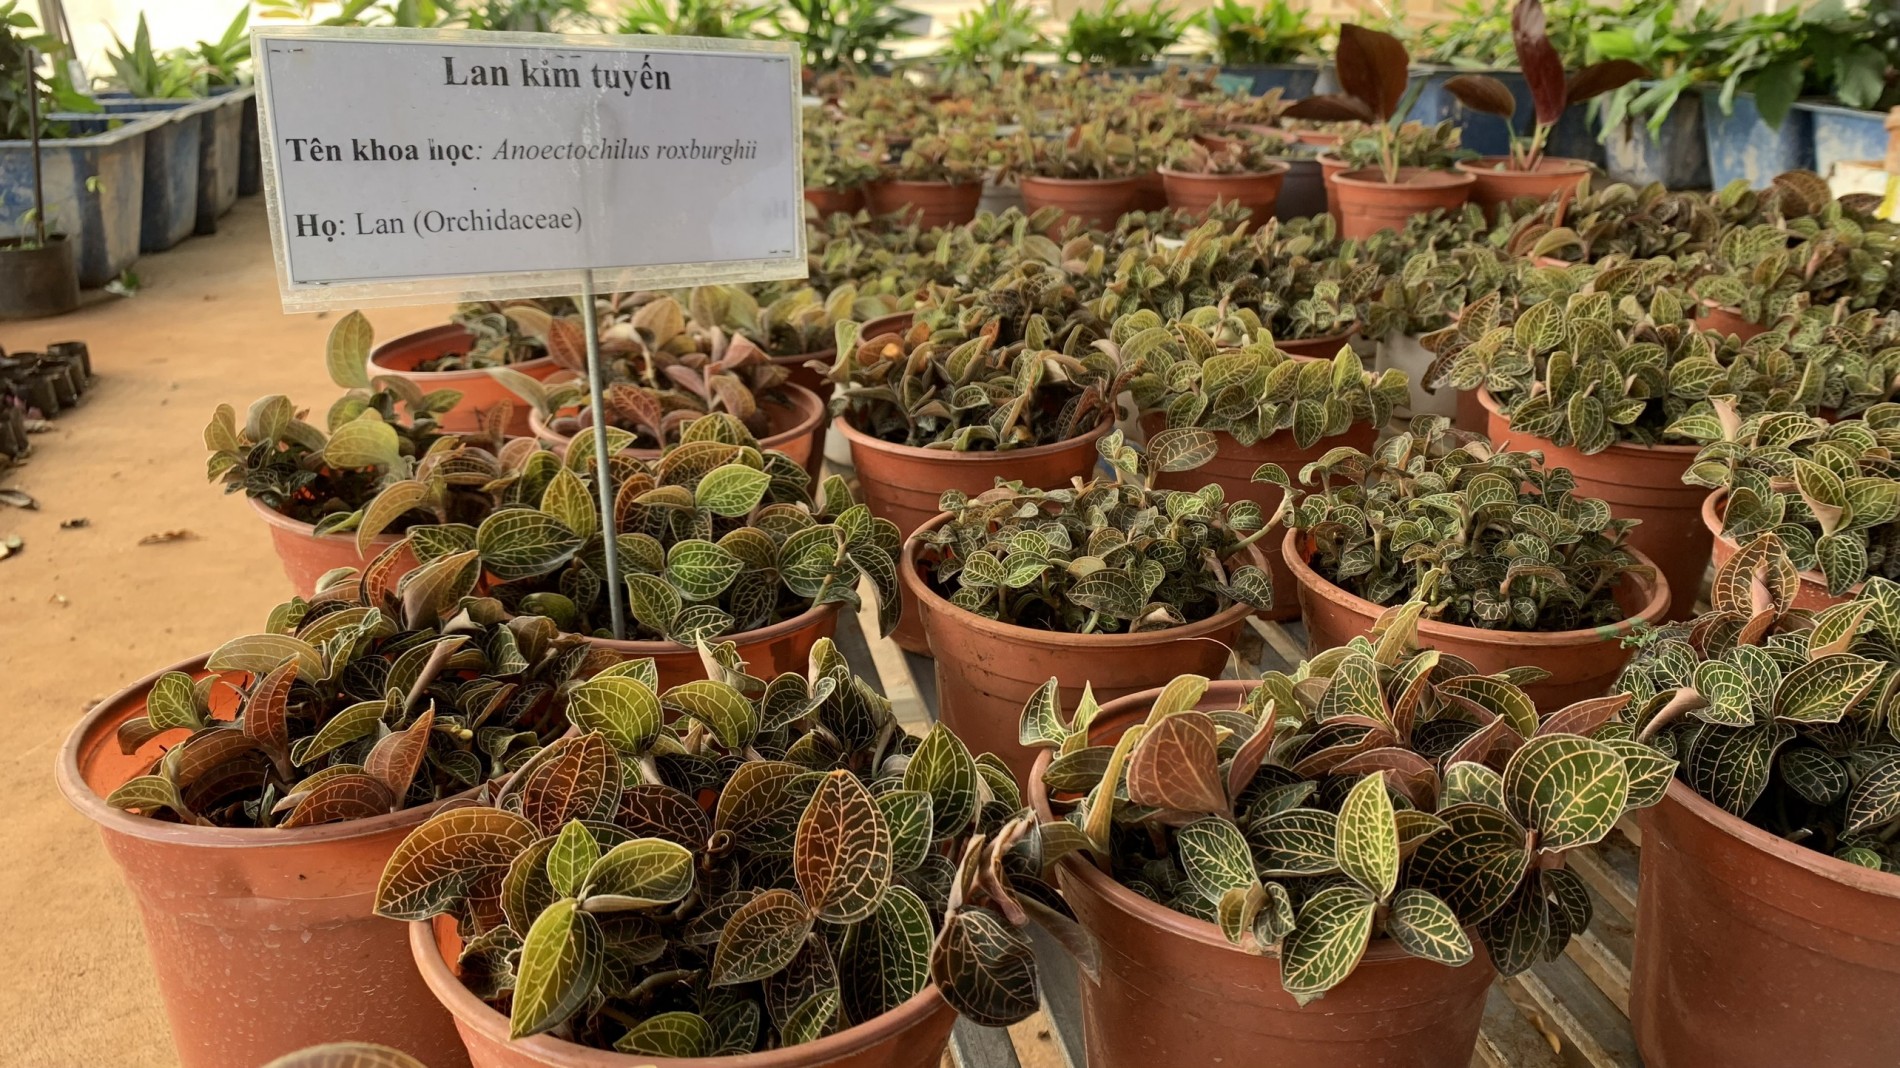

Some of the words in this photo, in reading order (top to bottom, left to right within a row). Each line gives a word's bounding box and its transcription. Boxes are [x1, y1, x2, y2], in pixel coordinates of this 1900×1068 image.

[441, 56, 510, 86] Lan
[590, 54, 672, 97] tuyến
[285, 137, 343, 162] Tên
[351, 138, 420, 162] khoa
[492, 138, 650, 160] Anoectochilus
[656, 138, 758, 166] roxburghii
[293, 213, 346, 243] Họ:
[354, 212, 405, 235] Lan
[413, 206, 583, 239] (Orchidaceae)
